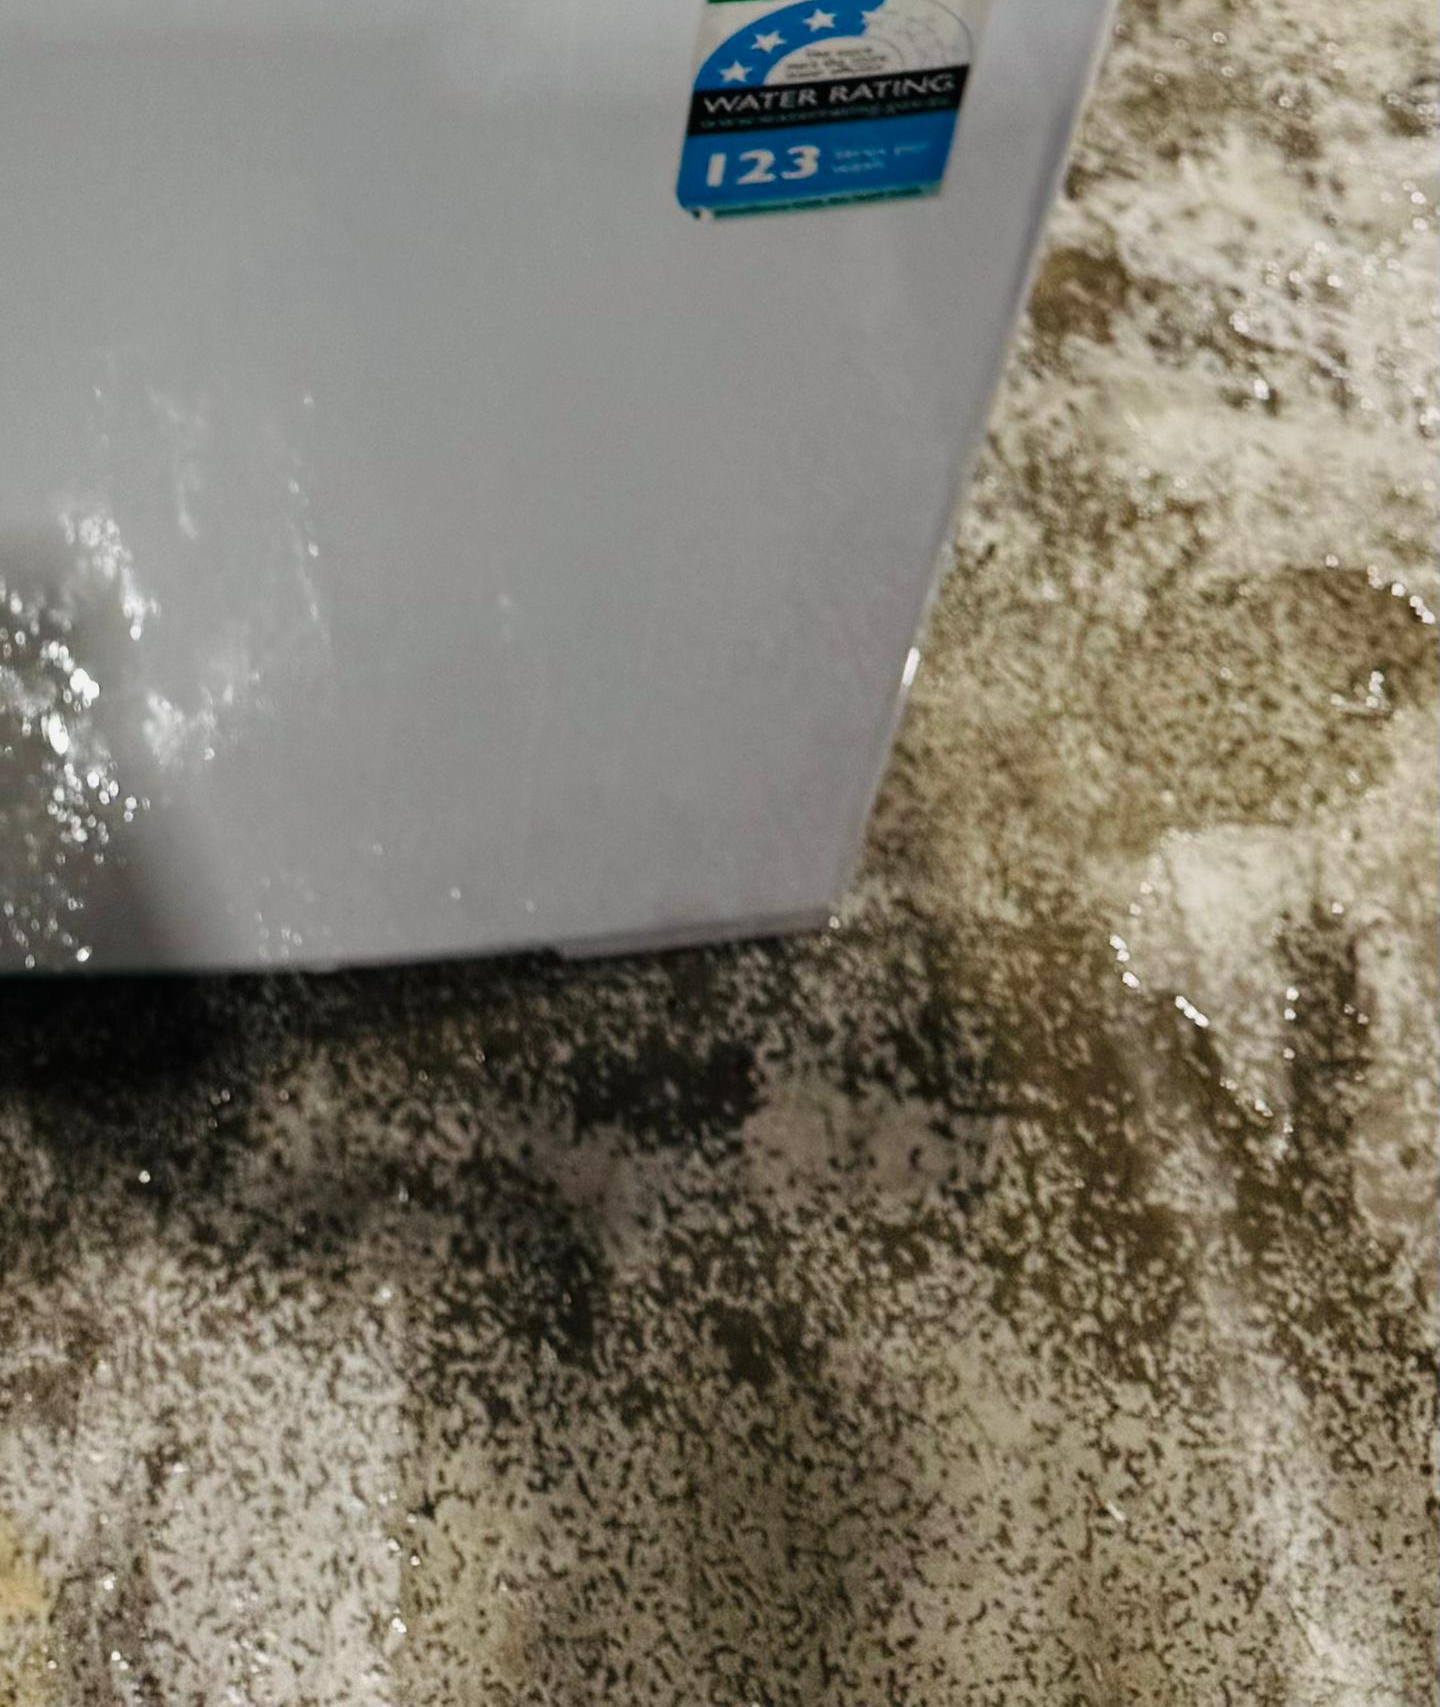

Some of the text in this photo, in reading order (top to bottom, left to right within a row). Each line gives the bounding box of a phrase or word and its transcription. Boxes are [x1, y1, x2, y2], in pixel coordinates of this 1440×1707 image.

[703, 73, 955, 115] WATER RATING
[706, 145, 821, 187] 123
